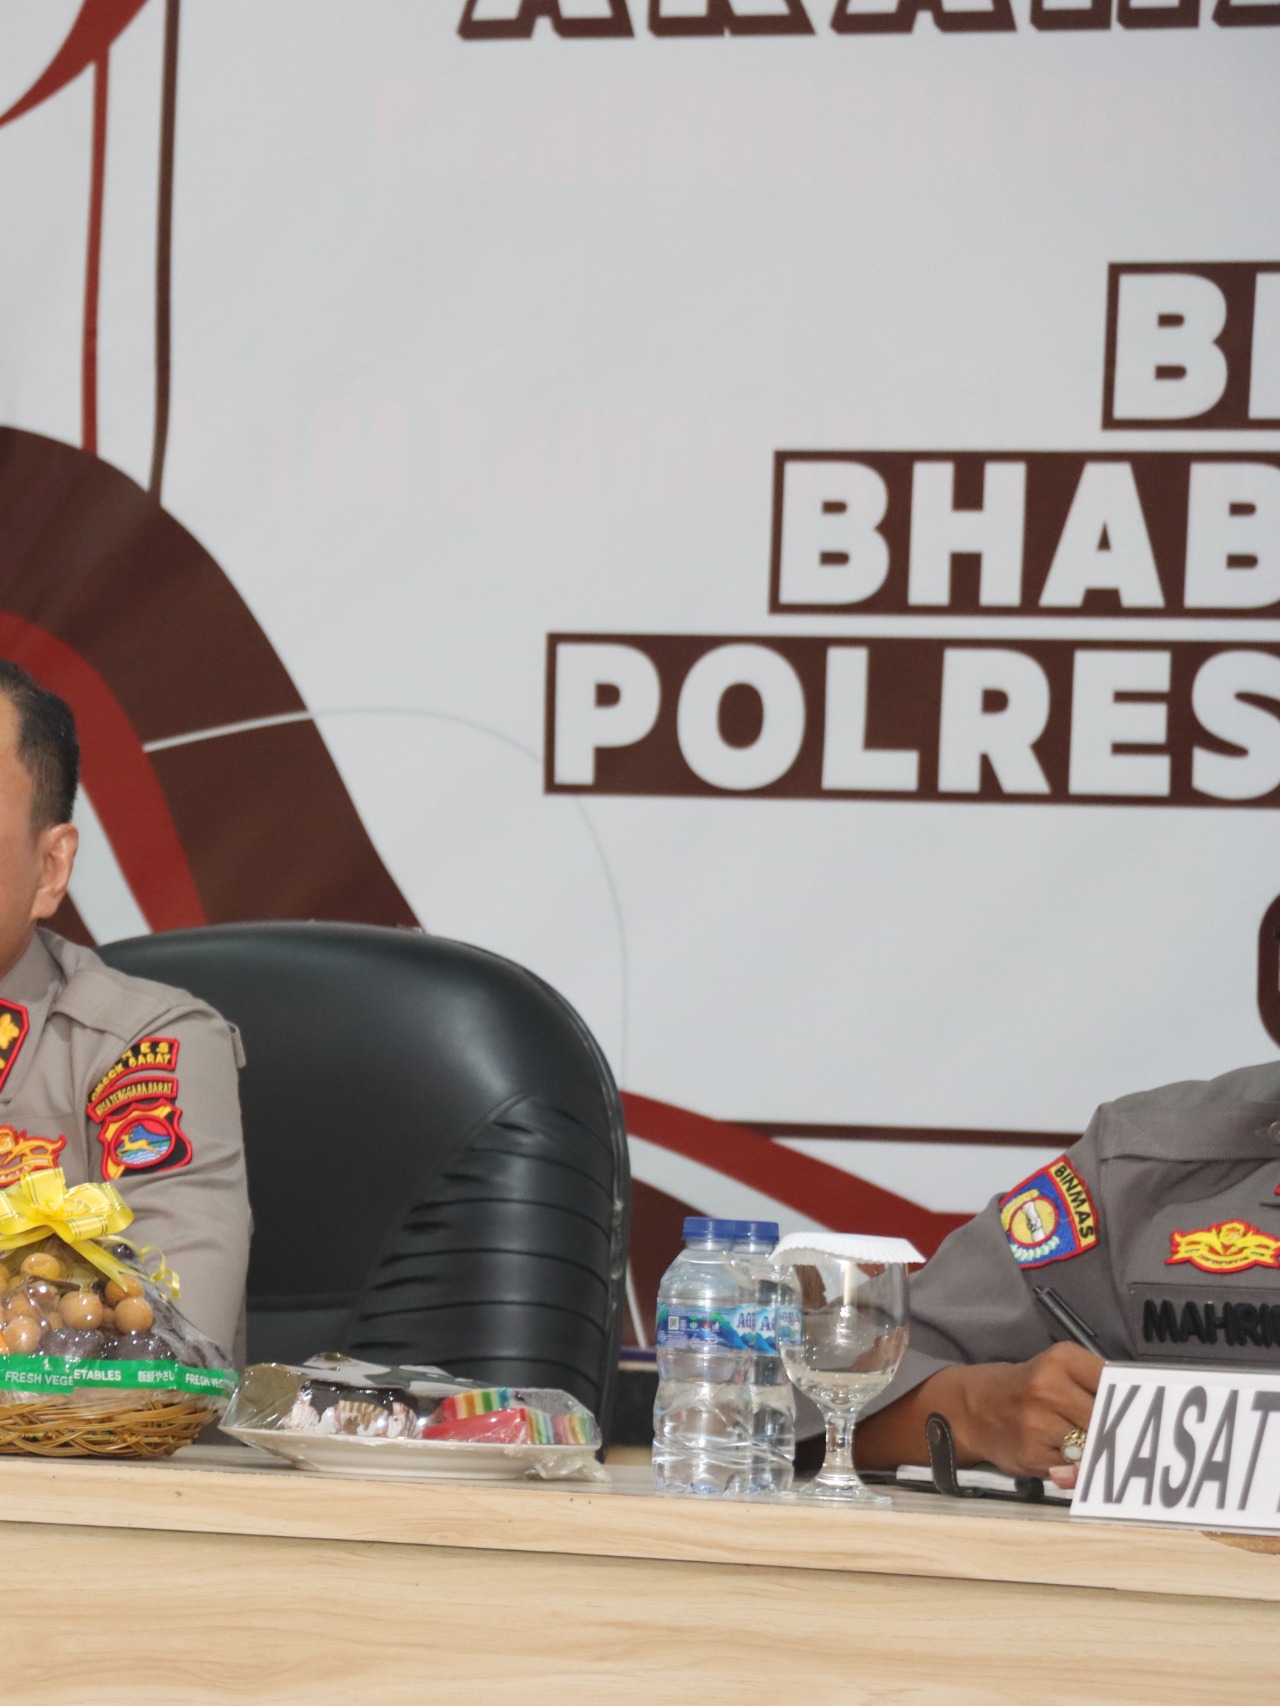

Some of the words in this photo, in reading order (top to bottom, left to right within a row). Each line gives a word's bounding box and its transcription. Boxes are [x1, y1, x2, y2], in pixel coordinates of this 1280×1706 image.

[779, 460, 1280, 609] BHAB
[554, 642, 1280, 800] POLRES
[1054, 1164, 1094, 1239] BINMAS
[4, 1371, 42, 1384] FRESH
[1079, 1384, 1280, 1515] KASAT
